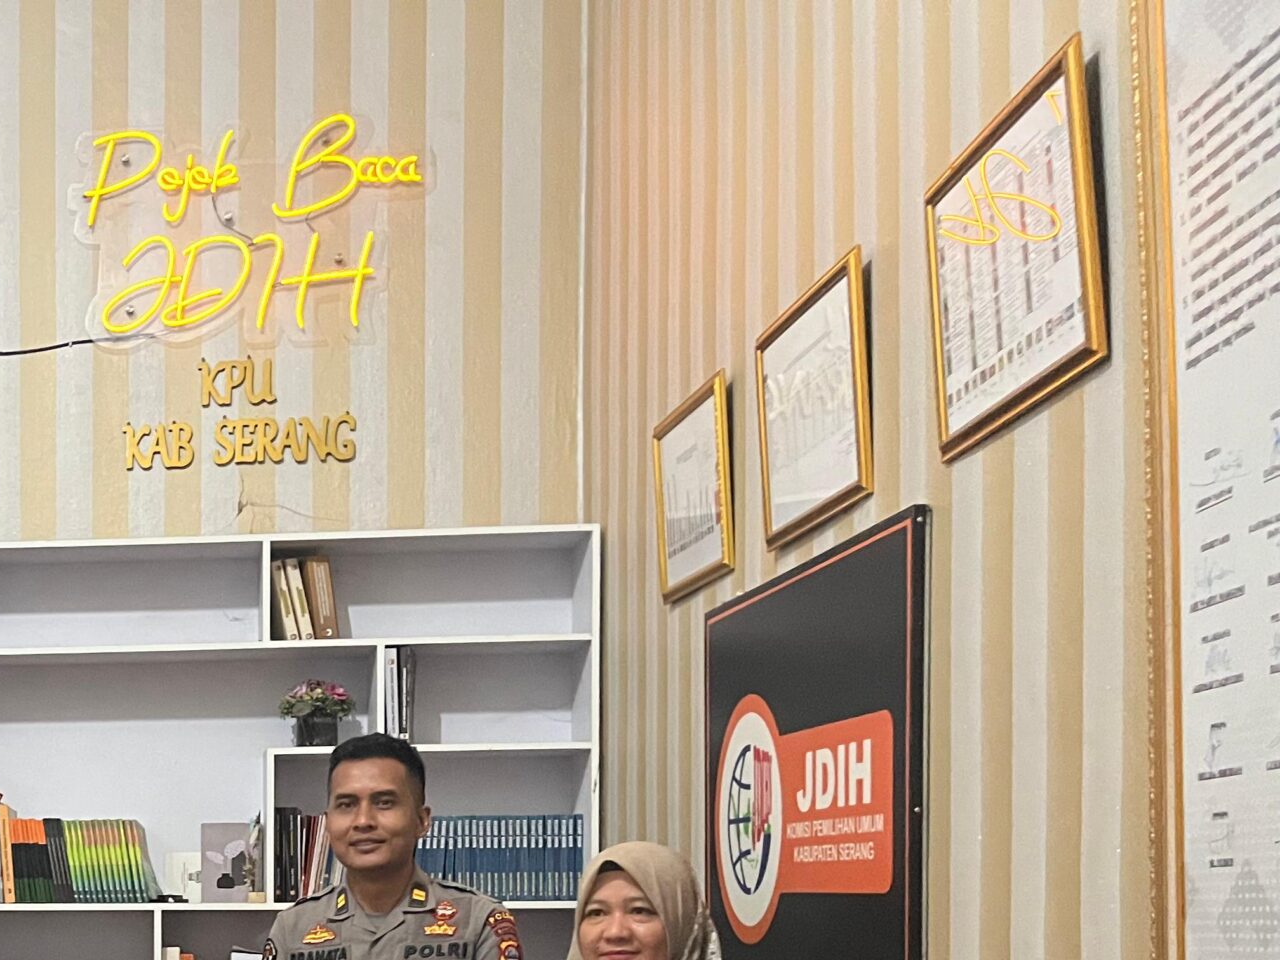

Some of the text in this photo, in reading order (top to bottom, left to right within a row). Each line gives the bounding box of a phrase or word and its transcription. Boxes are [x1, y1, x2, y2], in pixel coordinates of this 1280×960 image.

[84, 113, 422, 227] Pojok Baca
[101, 230, 375, 333] JDIH
[197, 356, 277, 407] KPU
[122, 412, 357, 470] KAB SERANG
[796, 738, 872, 813] JDIH
[786, 813, 884, 839] KOMISI PEMILIHAN UMUM
[793, 841, 875, 862] KABUPATEN SERANG
[403, 942, 468, 960] POLRI
